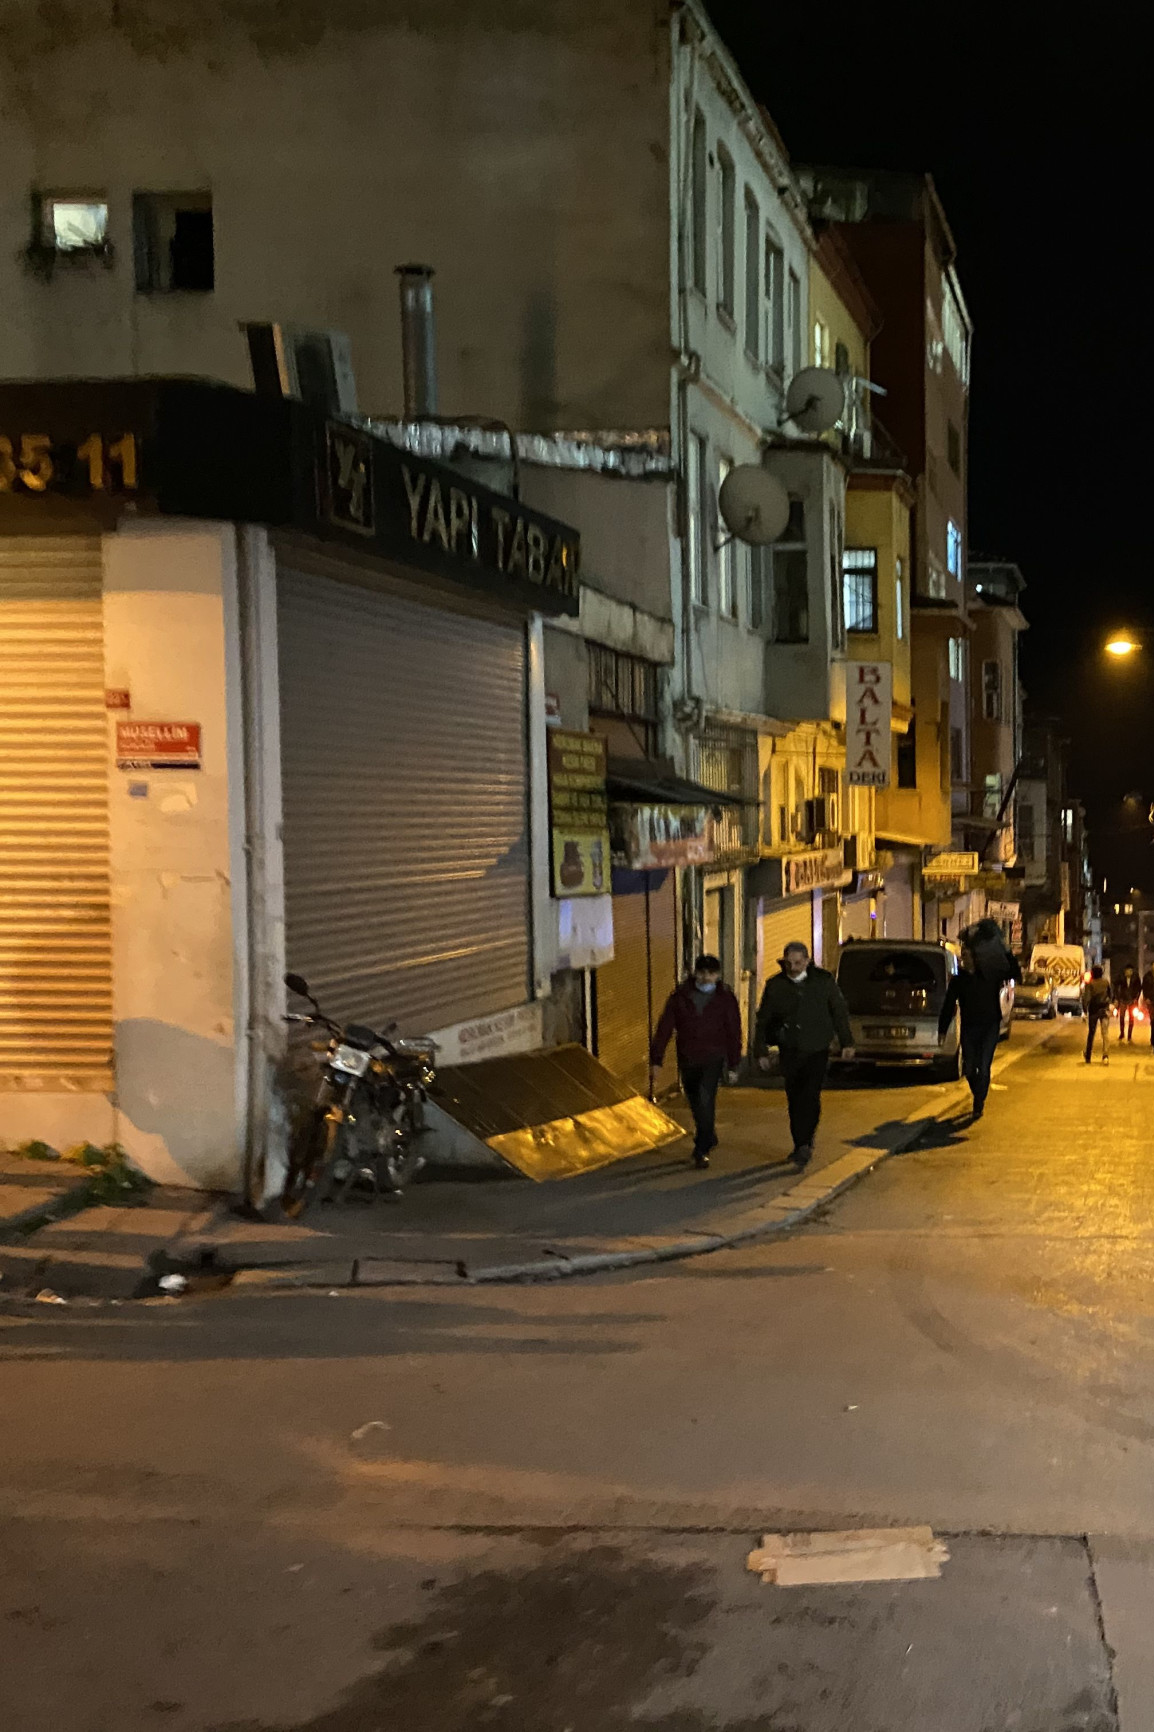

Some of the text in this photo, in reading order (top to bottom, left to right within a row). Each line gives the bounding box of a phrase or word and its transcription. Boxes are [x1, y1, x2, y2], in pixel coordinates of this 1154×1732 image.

[77, 432, 137, 490] 11
[401, 462, 480, 561] YAPI
[855, 666, 882, 767] BALTA
